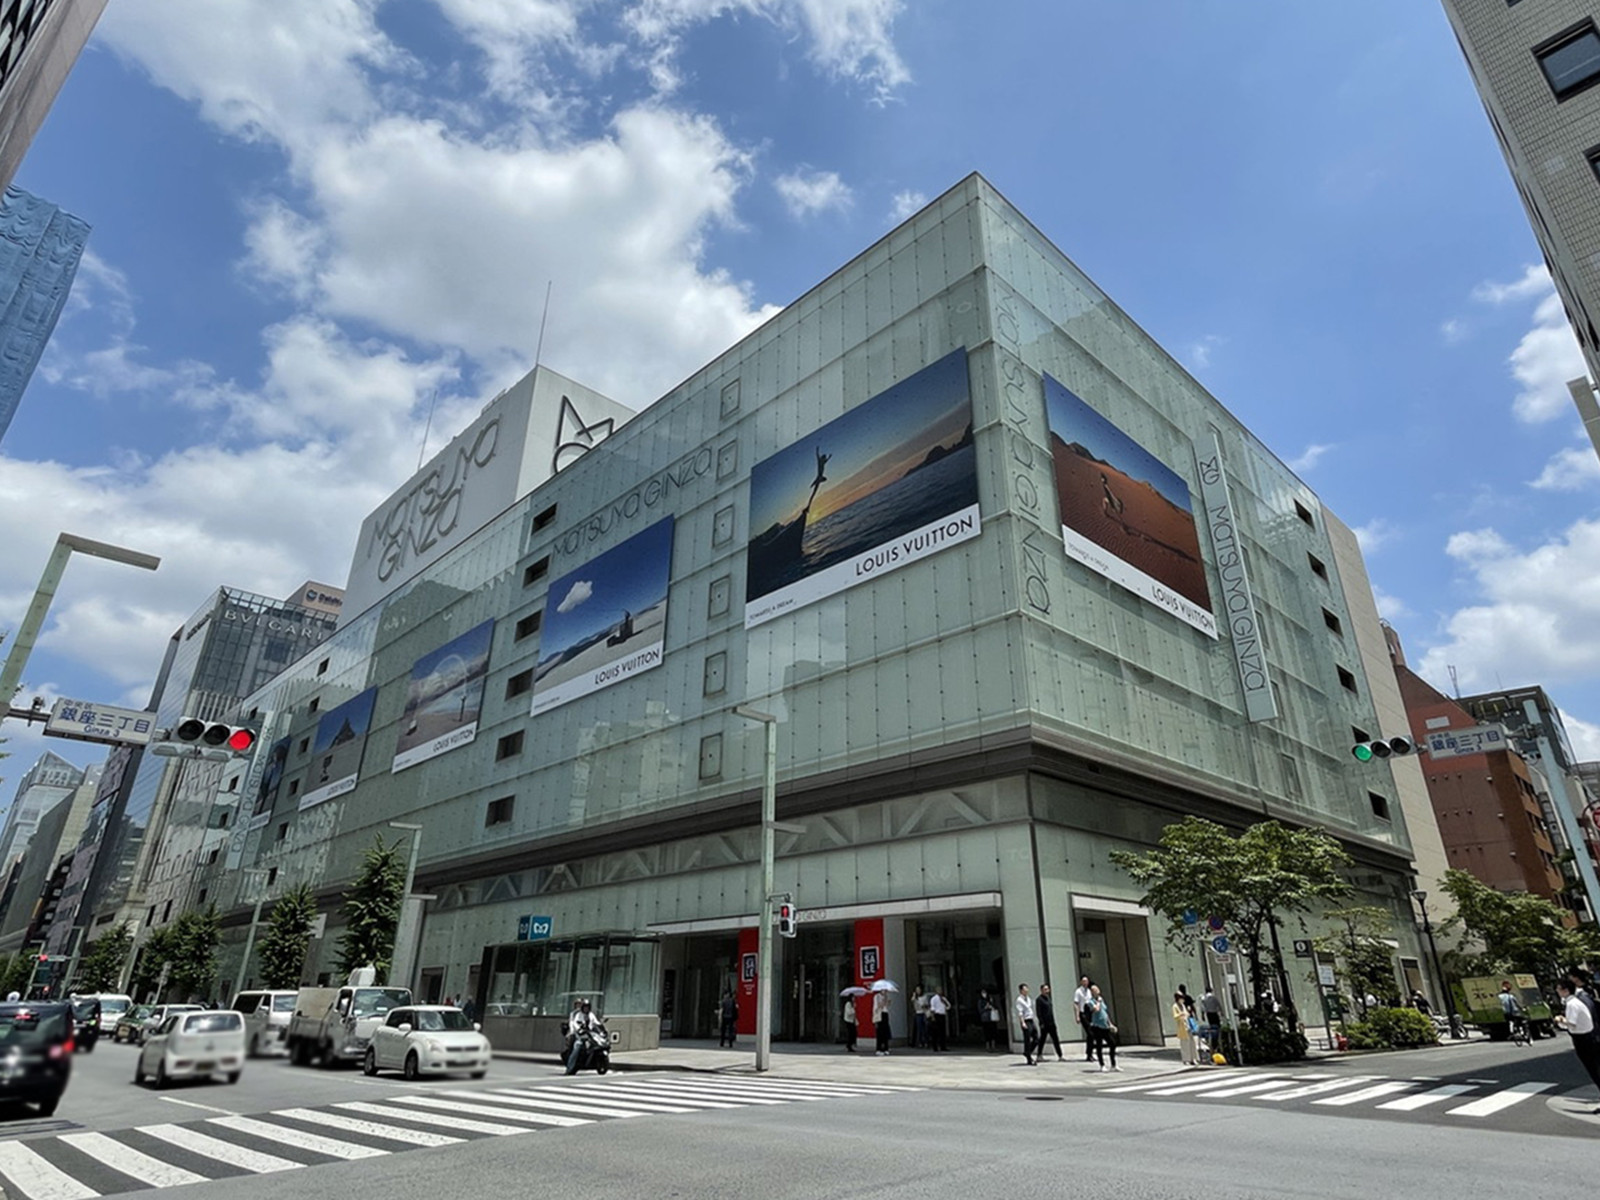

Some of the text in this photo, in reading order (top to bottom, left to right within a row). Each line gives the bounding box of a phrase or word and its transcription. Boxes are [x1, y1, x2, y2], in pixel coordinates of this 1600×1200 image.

[856, 515, 973, 576] LOUIS VUITTON
[1152, 585, 1215, 631] LOUIS VUITTON
[595, 648, 660, 685] LOUIS VUITTON
[60, 706, 150, 734] 銀座三丁目
[84, 724, 120, 737] Ginza 3
[1455, 746, 1474, 754] Ginza
